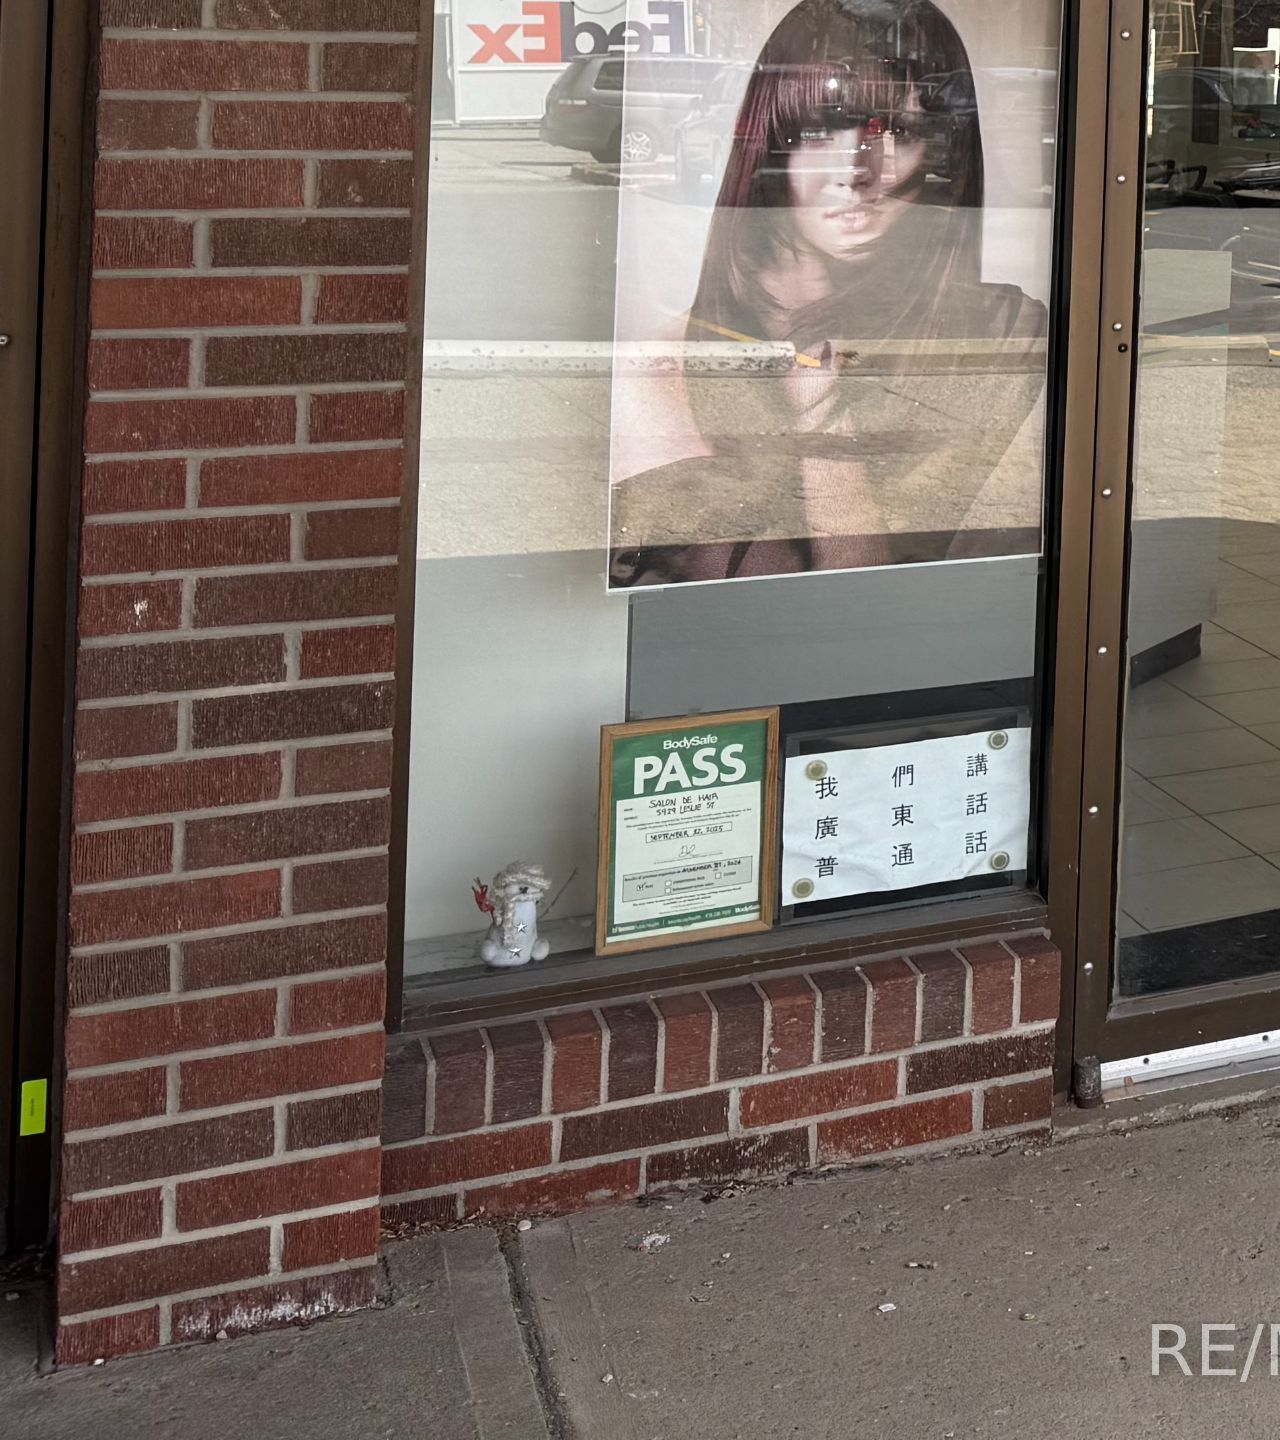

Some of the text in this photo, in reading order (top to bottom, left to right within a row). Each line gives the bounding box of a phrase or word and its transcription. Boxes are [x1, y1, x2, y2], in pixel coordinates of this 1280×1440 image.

[664, 734, 718, 750] BodySafe
[634, 744, 747, 795] PASS
[649, 798, 676, 809] SALON
[683, 796, 692, 804] DE
